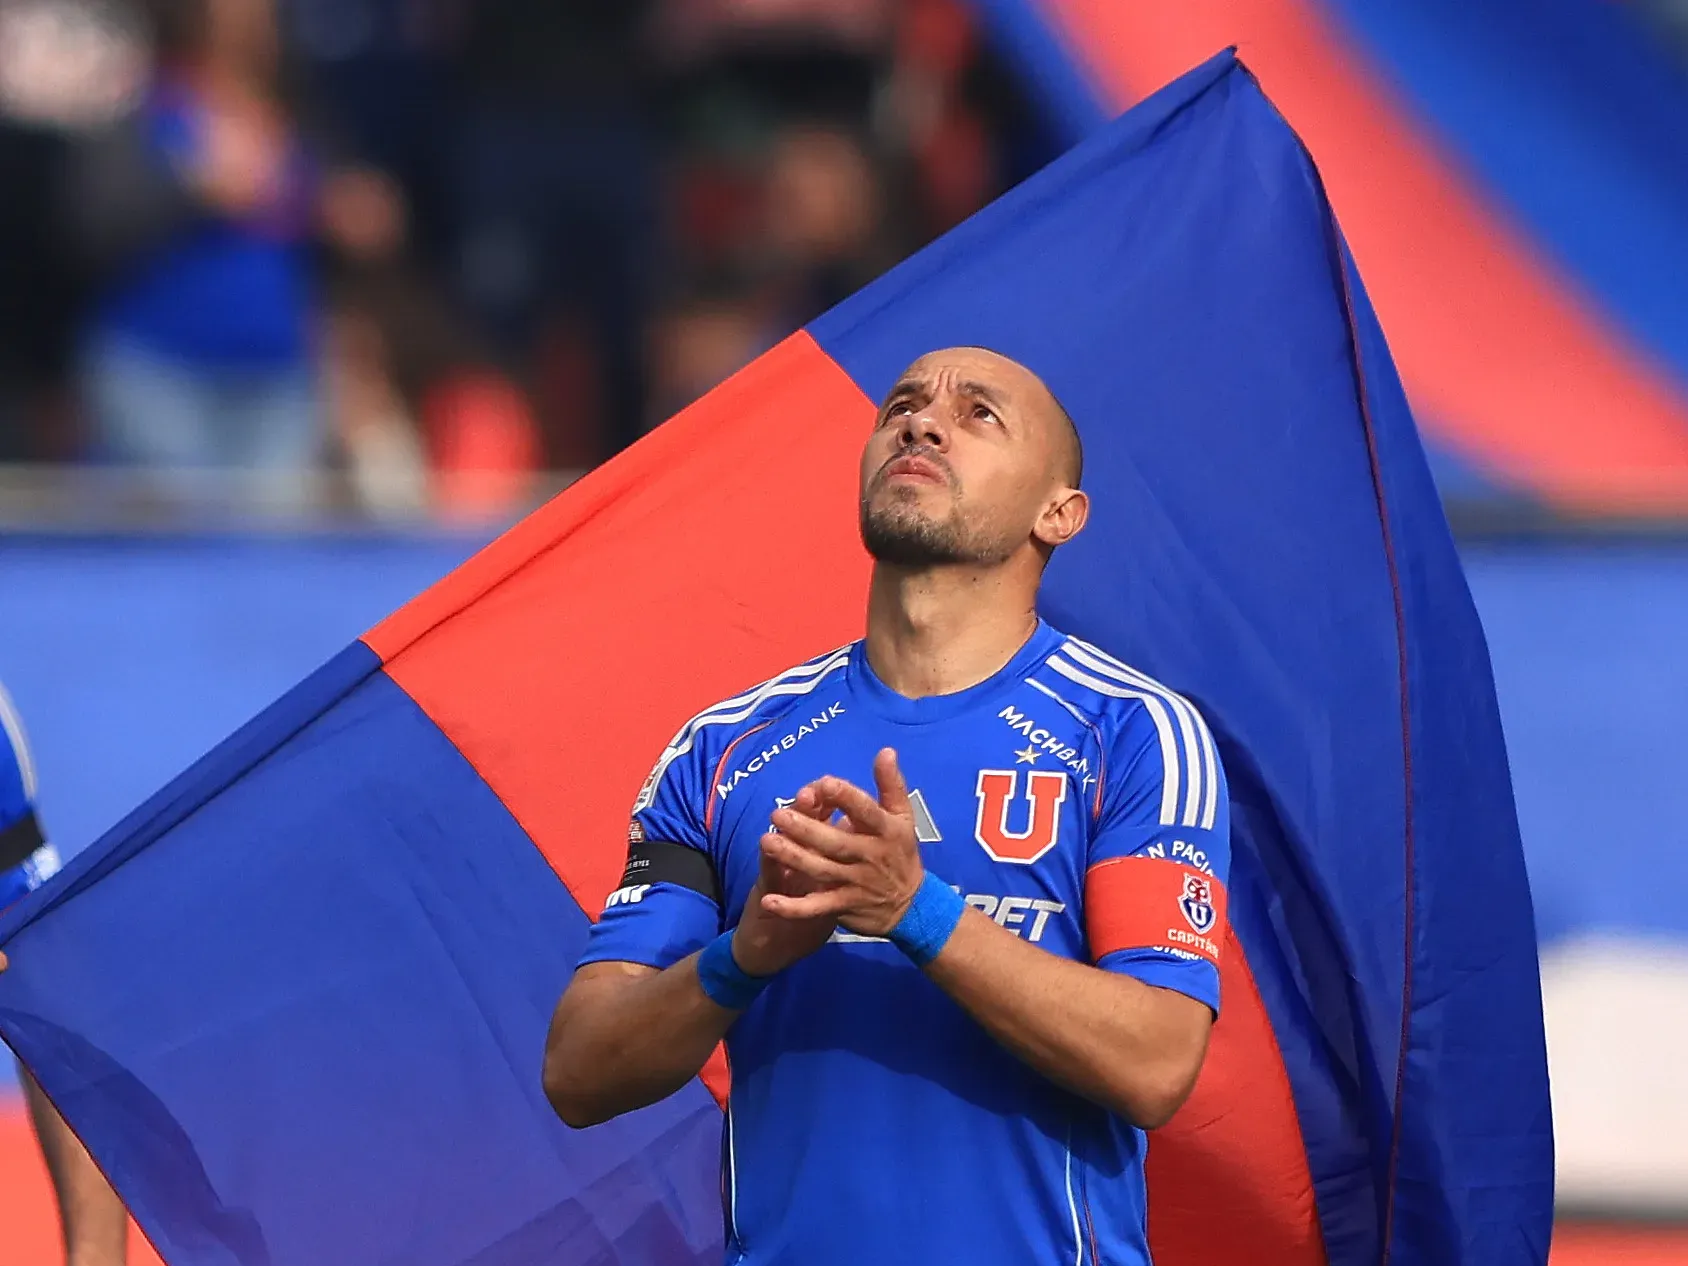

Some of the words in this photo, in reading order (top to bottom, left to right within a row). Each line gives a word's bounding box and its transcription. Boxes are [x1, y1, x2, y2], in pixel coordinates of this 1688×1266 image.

[716, 702, 845, 800] MACHBANK
[998, 705, 1096, 793] MACHBANK
[975, 769, 1067, 864] U
